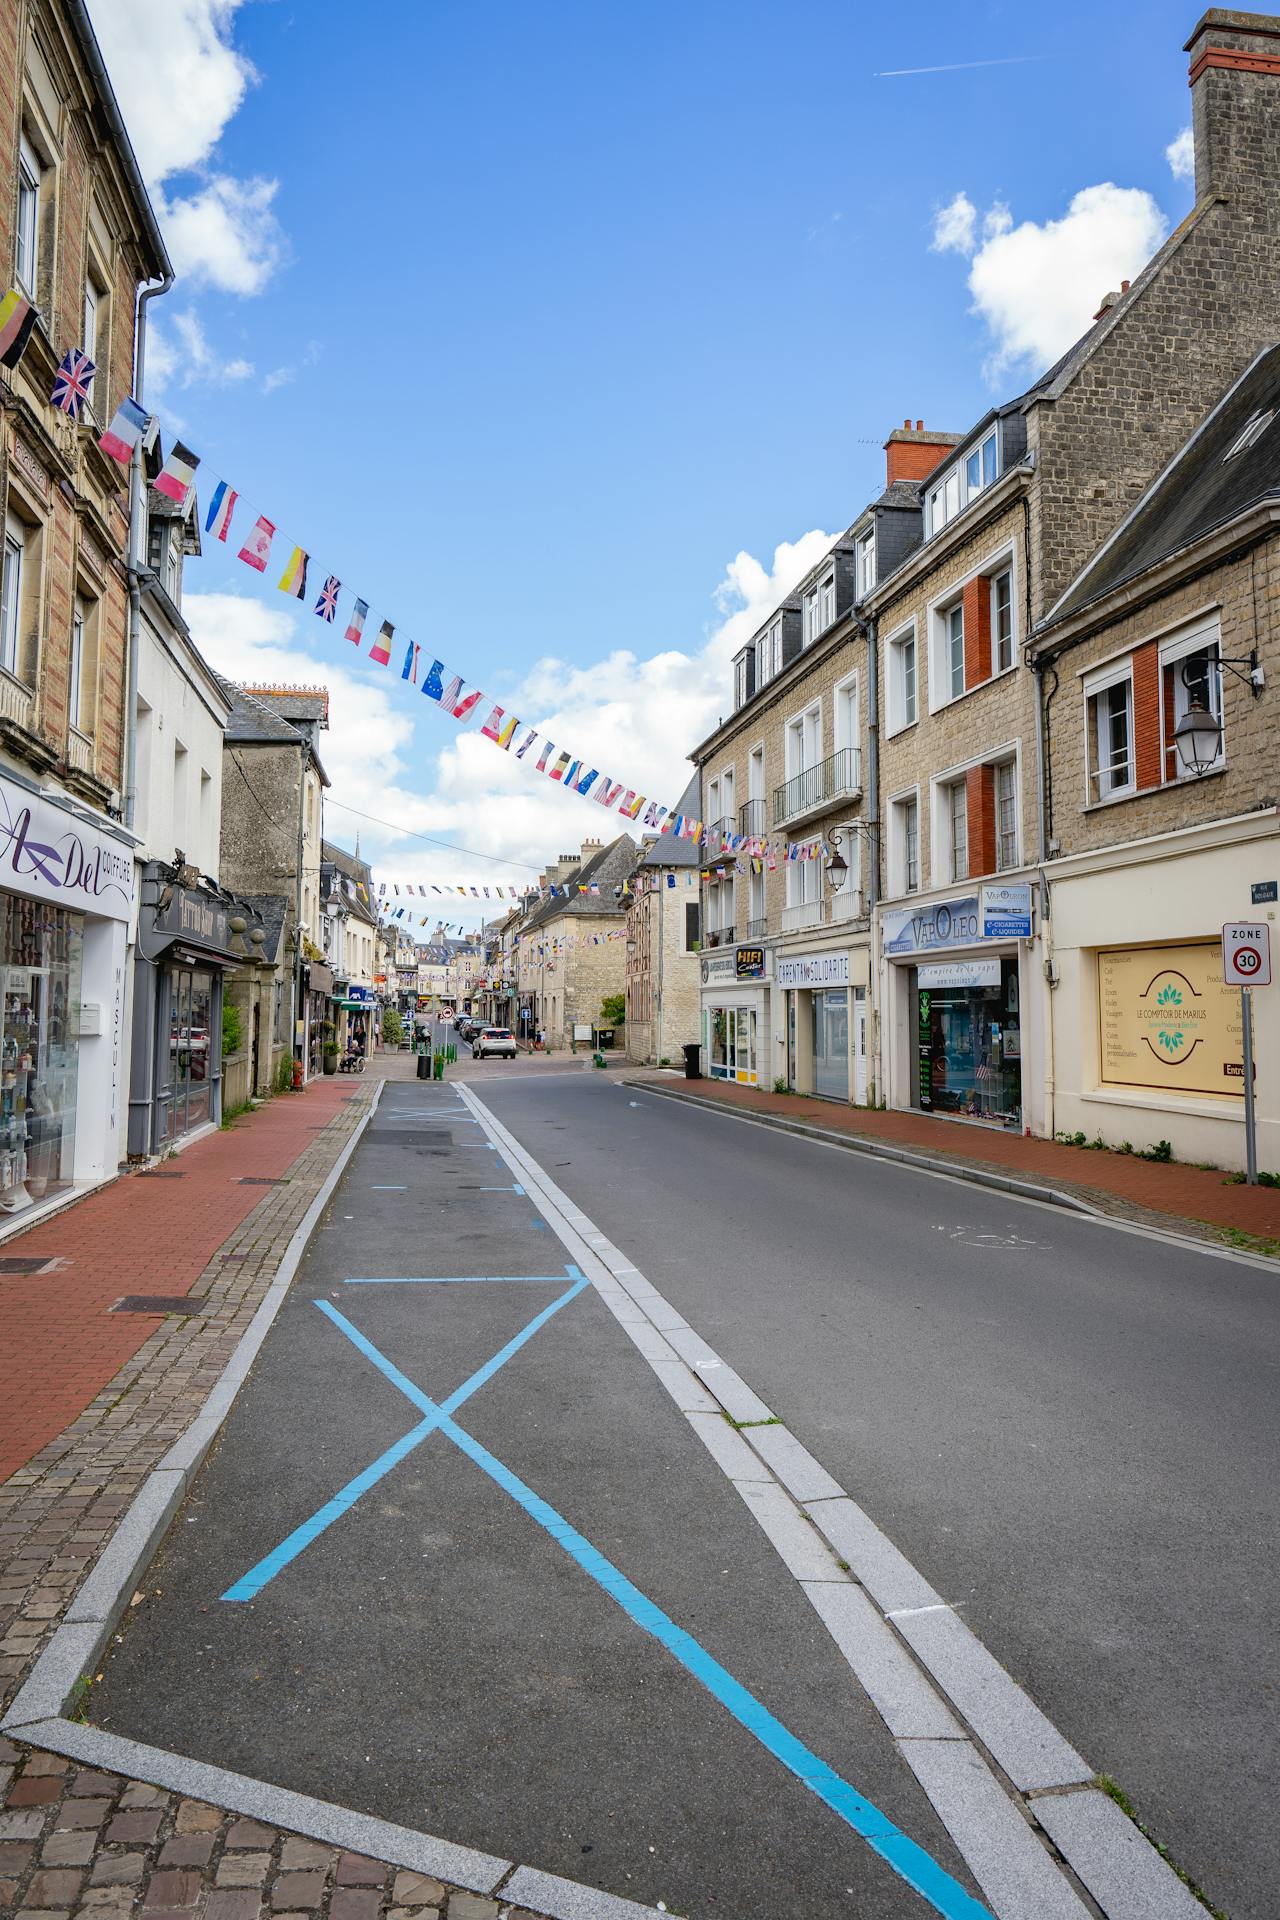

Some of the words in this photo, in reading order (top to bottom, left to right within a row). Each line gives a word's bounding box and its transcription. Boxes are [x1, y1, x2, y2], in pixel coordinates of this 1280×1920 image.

[102, 850, 131, 883] COIFFURE
[1231, 930, 1261, 939] ZONE
[737, 951, 762, 963] HIFI
[1239, 955, 1256, 967] 30
[779, 963, 808, 983] CARENTAN
[955, 965, 964, 973] de
[978, 965, 995, 973] vape
[1136, 1009, 1142, 1018] LE
[1143, 1009, 1173, 1019] COMPTOIR
[1174, 1009, 1181, 1019] DE
[1182, 1009, 1207, 1019] MARIUS
[110, 967, 121, 1130] MASCULIN
